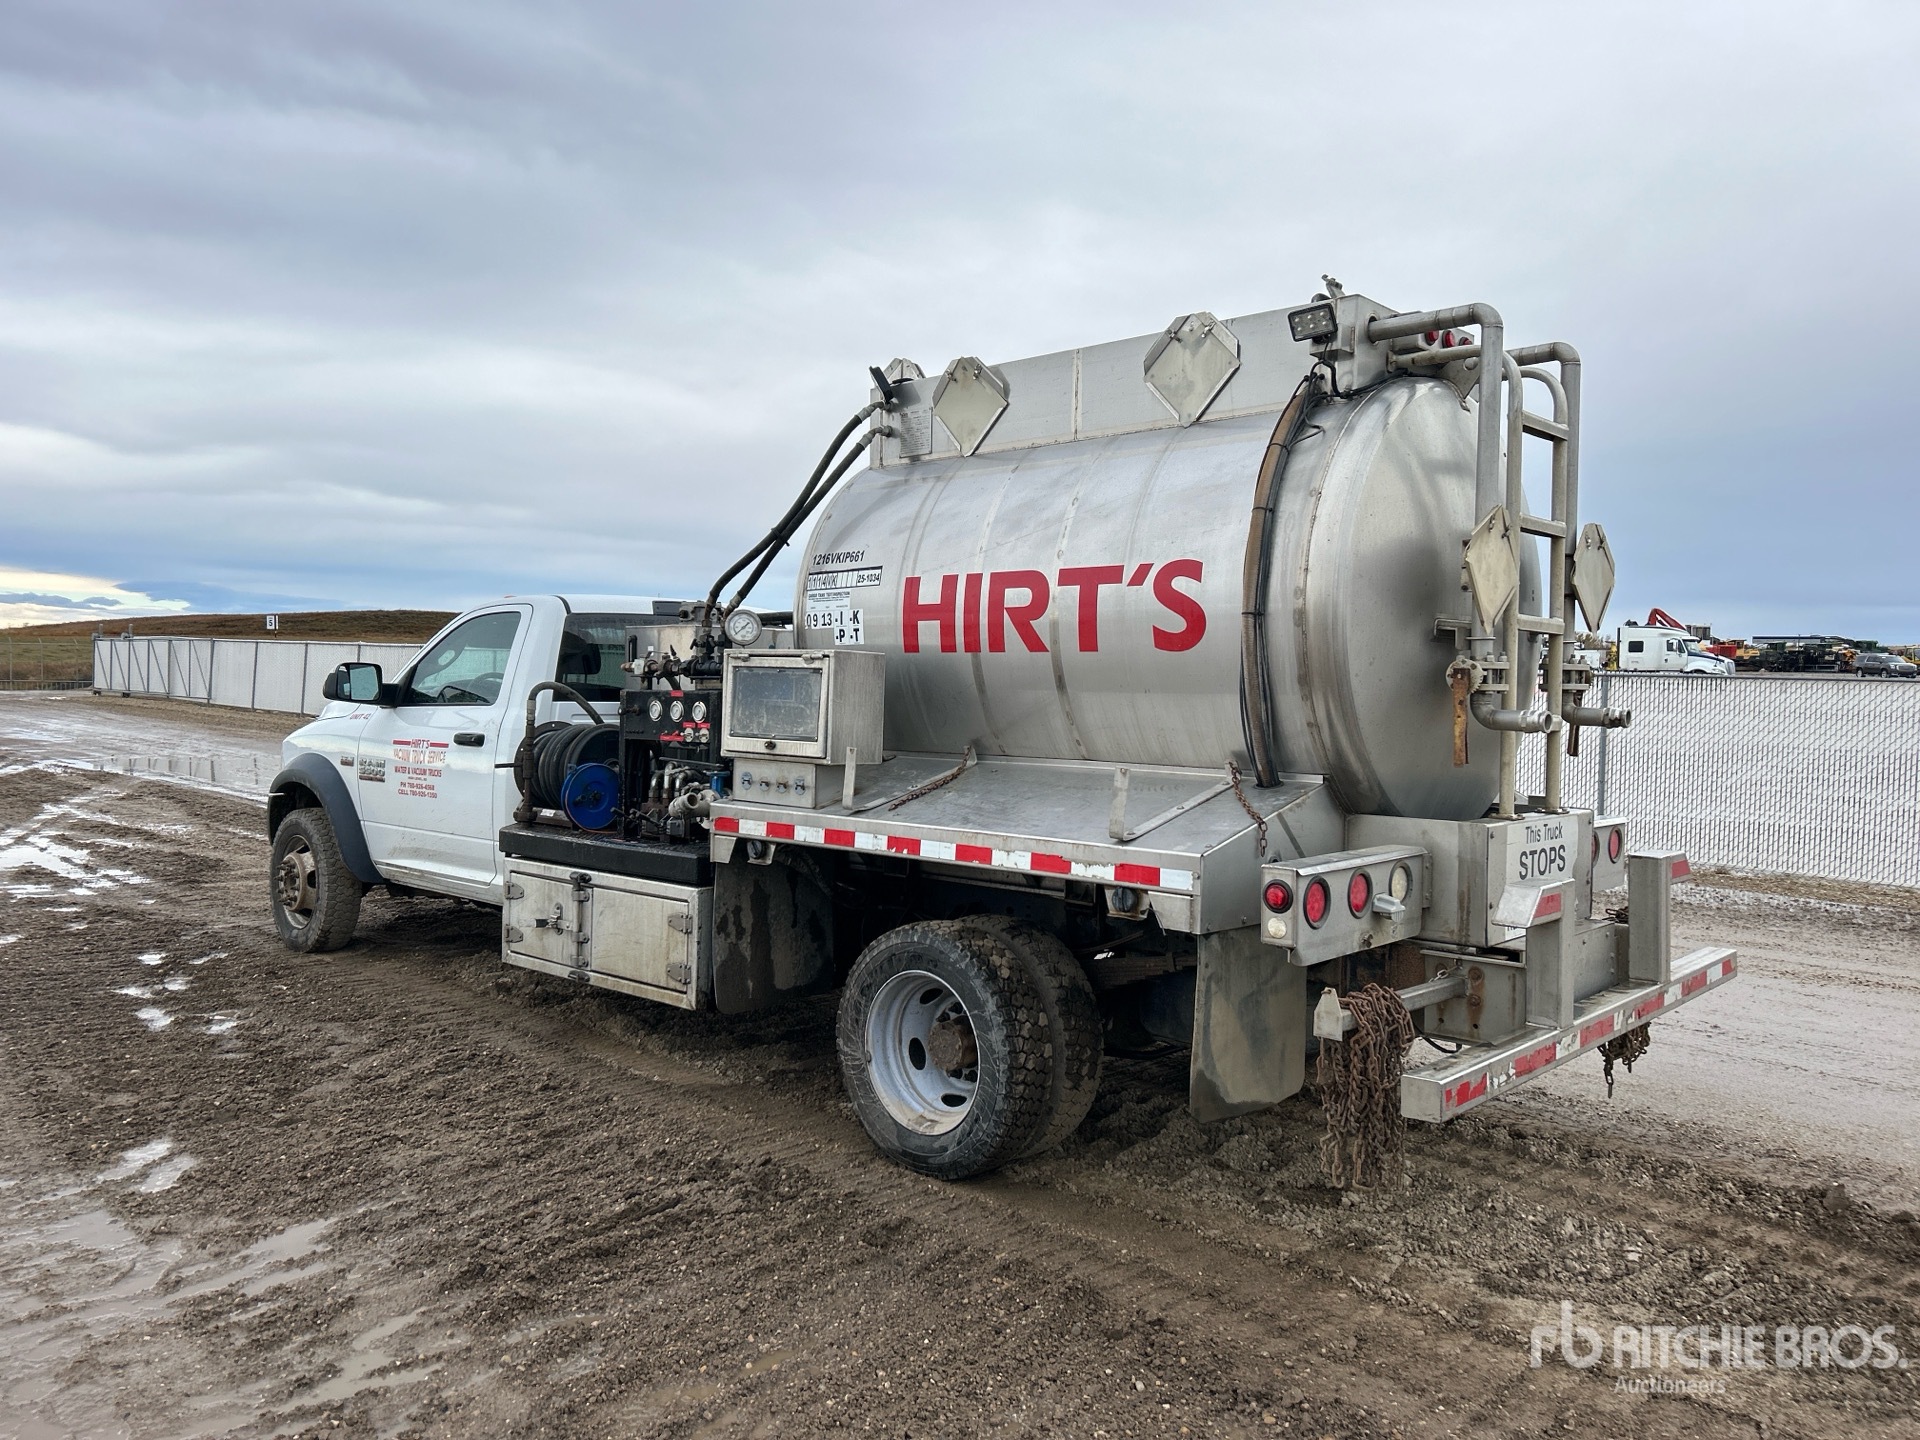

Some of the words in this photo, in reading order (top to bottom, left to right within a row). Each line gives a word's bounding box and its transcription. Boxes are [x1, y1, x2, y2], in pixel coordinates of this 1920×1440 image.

[813, 550, 865, 565] 1216VKIP661
[857, 573, 880, 584] 25-1034
[903, 558, 1207, 653] HIRT'S
[821, 612, 832, 627] 13
[412, 750, 426, 764] TRUCK
[428, 751, 446, 764] SERVICE
[394, 766, 407, 774] WATER
[411, 767, 427, 776] VACUUM
[428, 768, 442, 778] TRUCKS
[1525, 825, 1541, 844] This
[1543, 821, 1563, 841] Truck
[1519, 844, 1566, 880] STOPS
